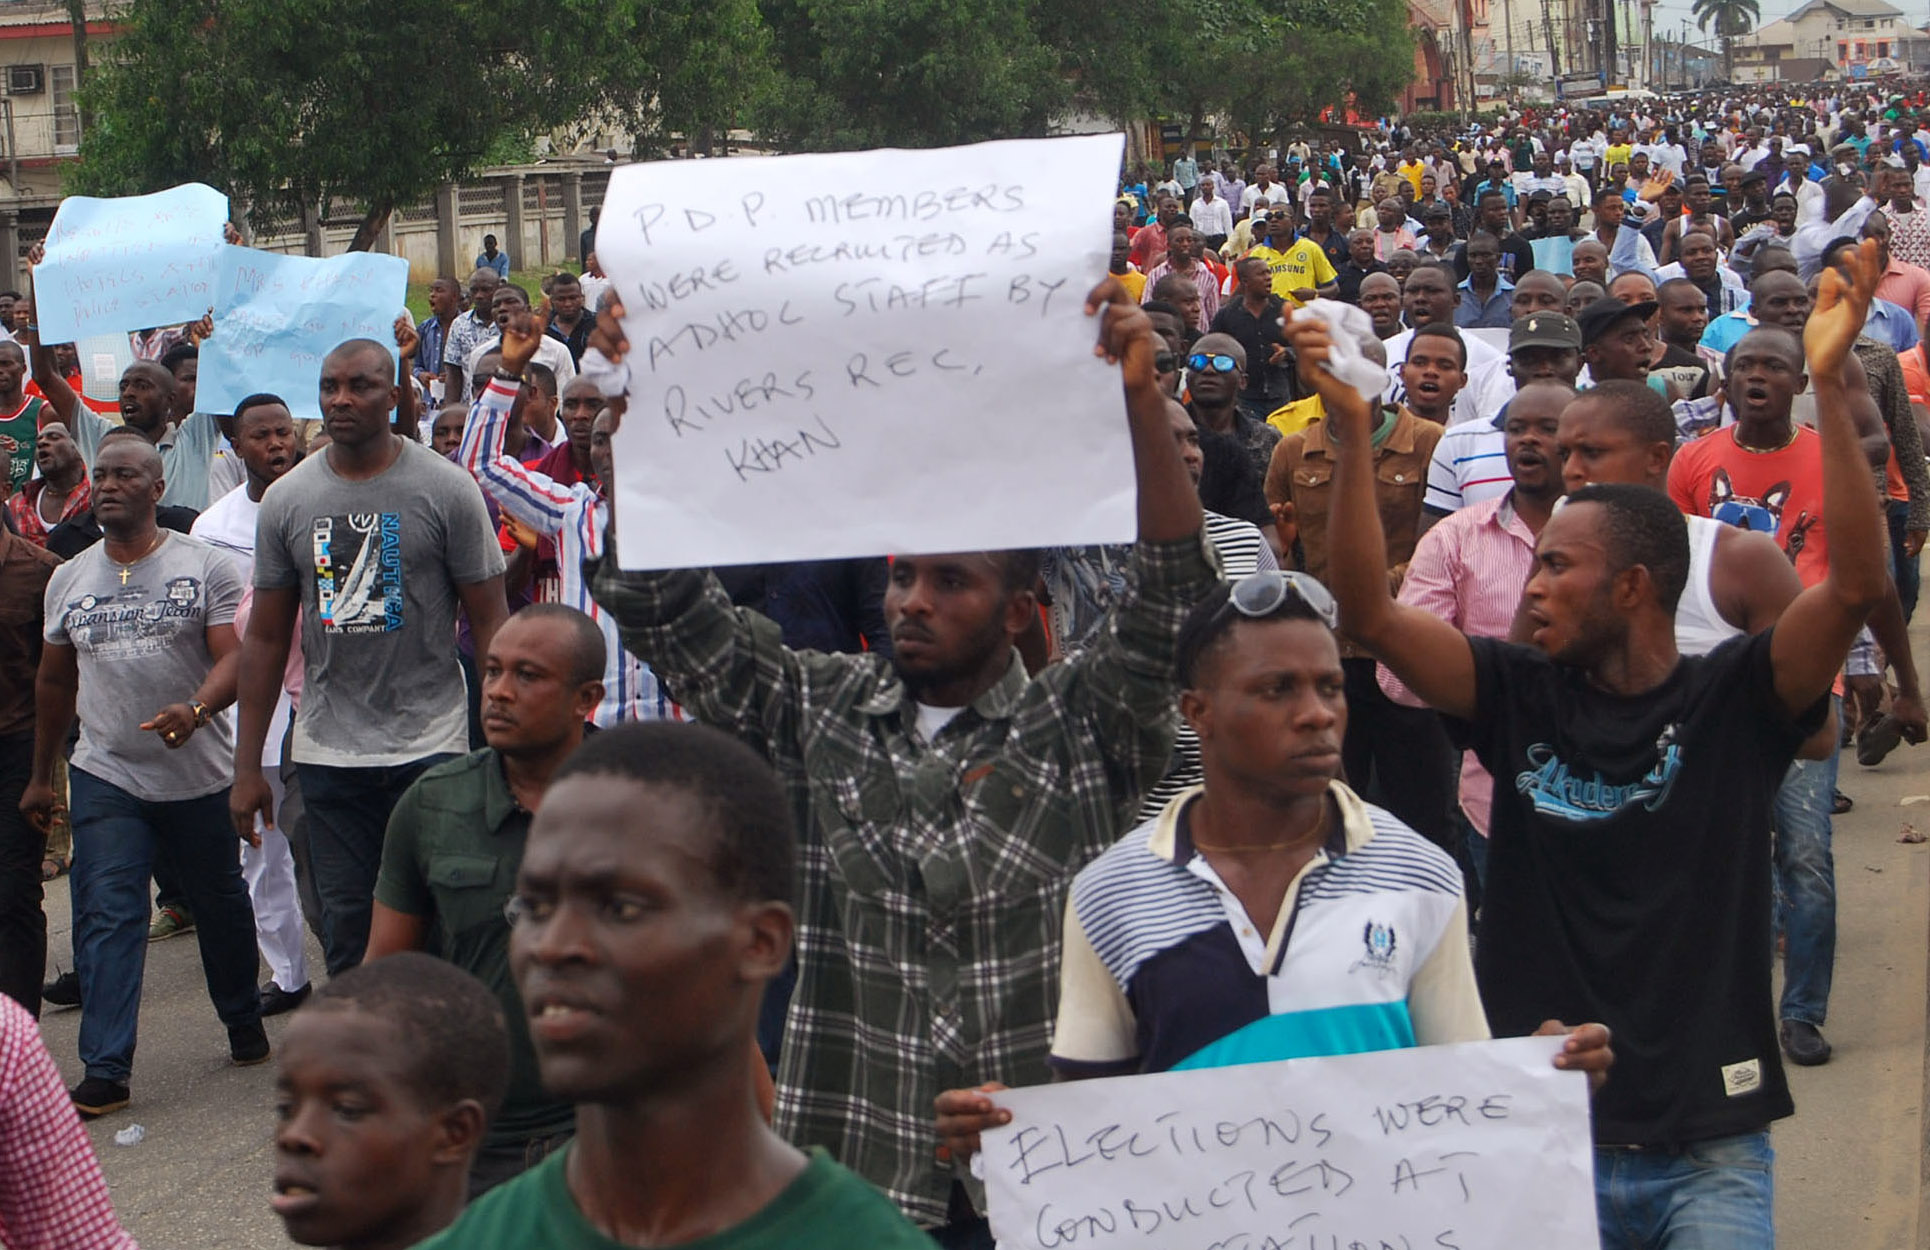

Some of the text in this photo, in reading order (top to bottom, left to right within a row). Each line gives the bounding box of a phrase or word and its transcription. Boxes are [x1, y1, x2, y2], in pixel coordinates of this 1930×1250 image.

[805, 184, 1024, 223] MEMBERS
[640, 231, 1040, 310] WERE RECRUITED AS
[1270, 264, 1305, 274] AMSUNG
[650, 273, 1068, 372] ADHOC STAFF BY
[664, 370, 813, 438] RIVERS
[725, 413, 841, 482] KHAN
[1009, 1095, 1512, 1185] ELECTIONS WERE
[1036, 1151, 1479, 1248] CONDUCTED AT
